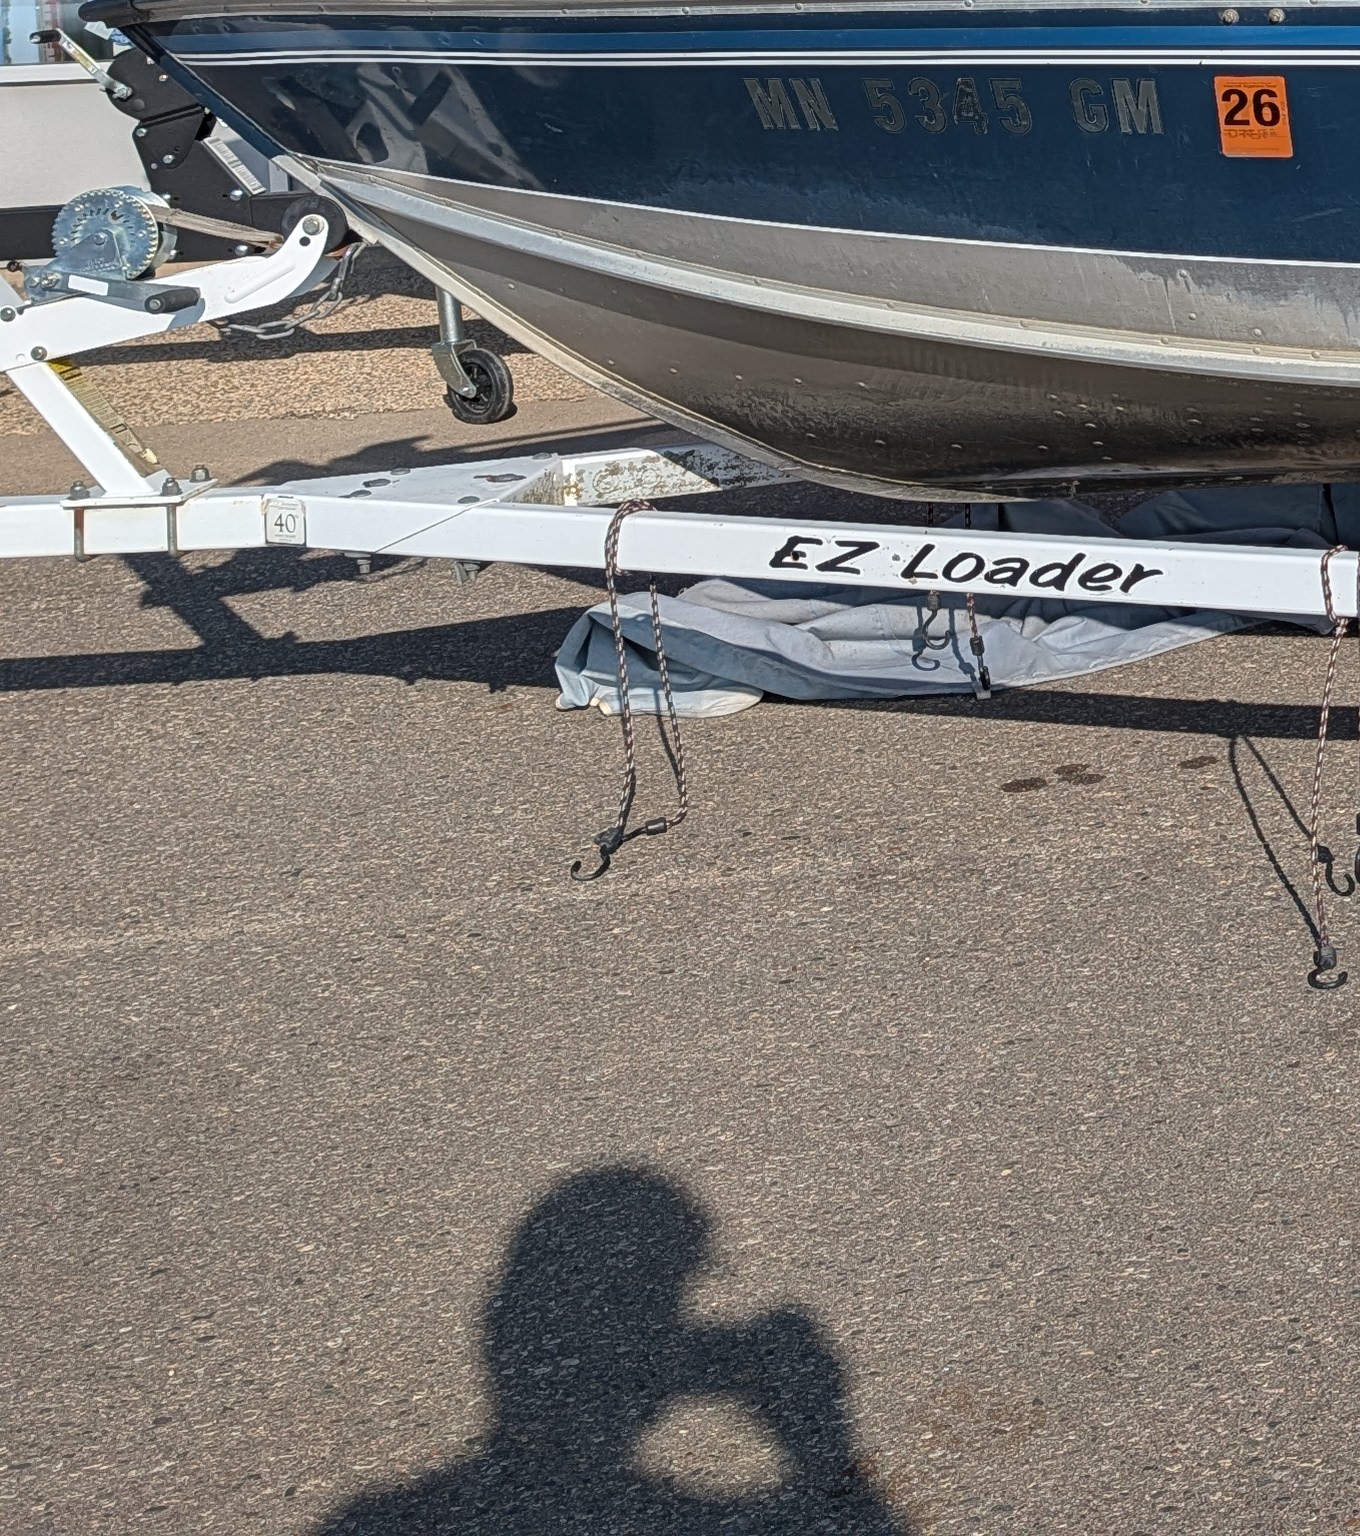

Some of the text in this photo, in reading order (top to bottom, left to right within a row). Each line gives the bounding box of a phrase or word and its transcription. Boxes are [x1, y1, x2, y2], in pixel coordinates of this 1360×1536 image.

[741, 77, 839, 132] MN
[1068, 77, 1164, 135] GM
[1221, 88, 1281, 127] 26
[273, 513, 297, 534] 40
[768, 535, 1164, 595] EZ Loader
